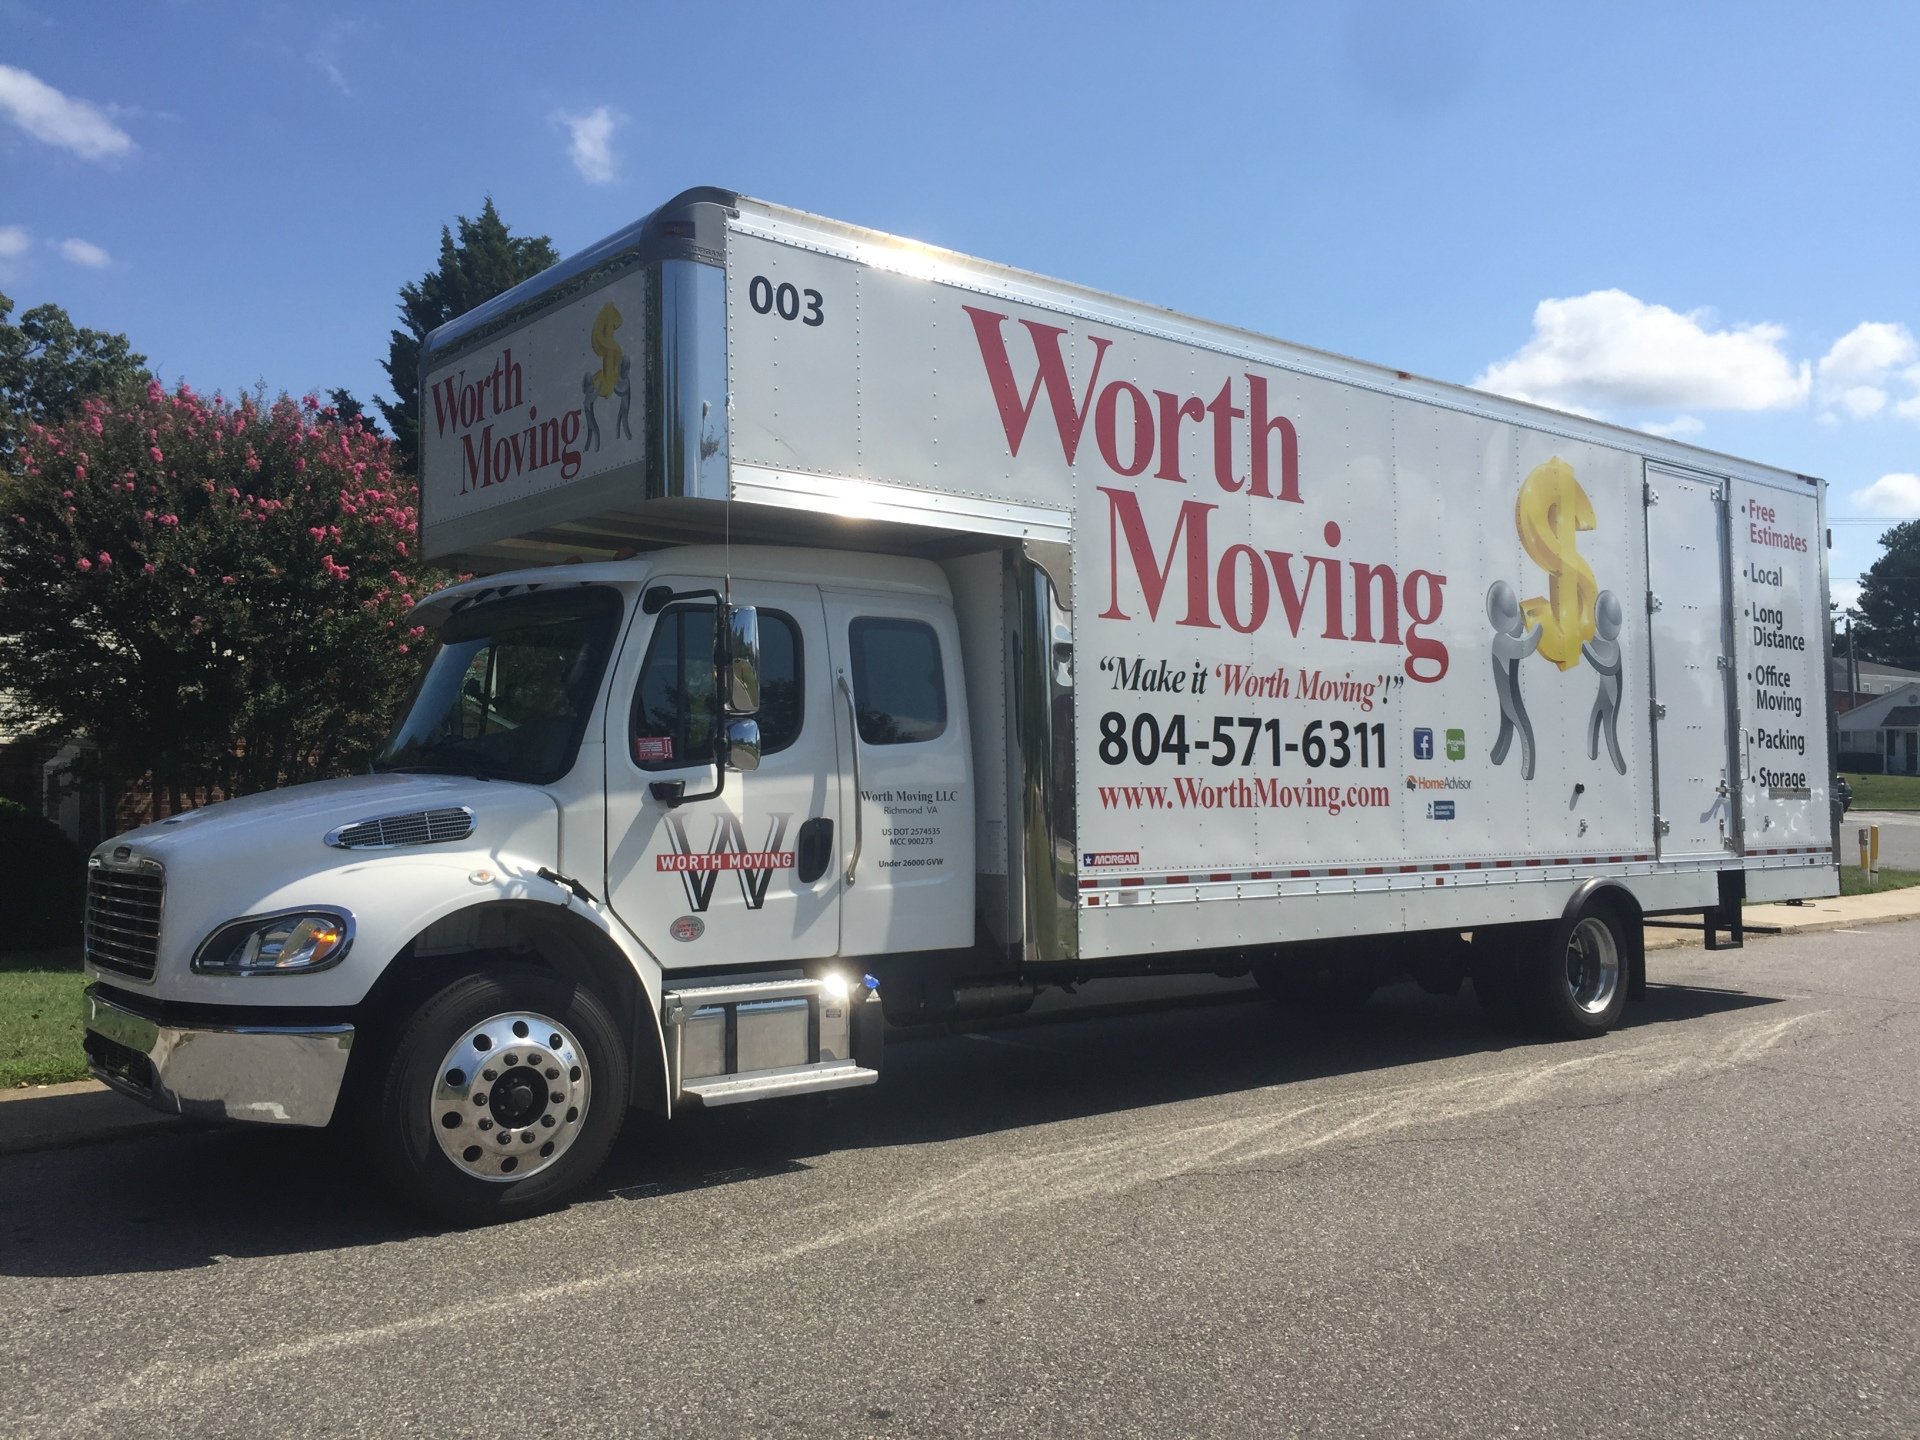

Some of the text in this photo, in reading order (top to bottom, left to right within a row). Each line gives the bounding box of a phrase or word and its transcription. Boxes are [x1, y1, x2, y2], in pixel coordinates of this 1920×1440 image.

[748, 275, 825, 327] 003
[431, 348, 524, 440] Worth
[962, 304, 1304, 504] Worth
[459, 406, 582, 496] Moving
[1748, 498, 1776, 524] Free
[1750, 522, 1808, 553] Estimates
[1096, 486, 1449, 684] Moving
[1750, 562, 1783, 587] Local
[1752, 601, 1783, 631] Long
[1753, 625, 1805, 652] Distance
[1191, 661, 1209, 695] it
[1755, 664, 1791, 688] Office
[1756, 688, 1802, 718] Moving
[1098, 711, 1386, 769] 804-571-6311
[1757, 728, 1805, 756] Packing
[1418, 776, 1472, 790] HomeAdvisor
[1759, 766, 1806, 793] Storage
[861, 790, 958, 804] Worth Moving LLC
[1098, 776, 1390, 816] www.WorthMoving.com
[883, 805, 938, 815] Richmond VA
[882, 828, 892, 836] US
[893, 827, 909, 836] DOT
[889, 837, 906, 846] MCC
[661, 853, 792, 870] WORTH MOVING
[878, 858, 944, 868] Under 26000 GVW
[1094, 854, 1138, 865] MORGAN
